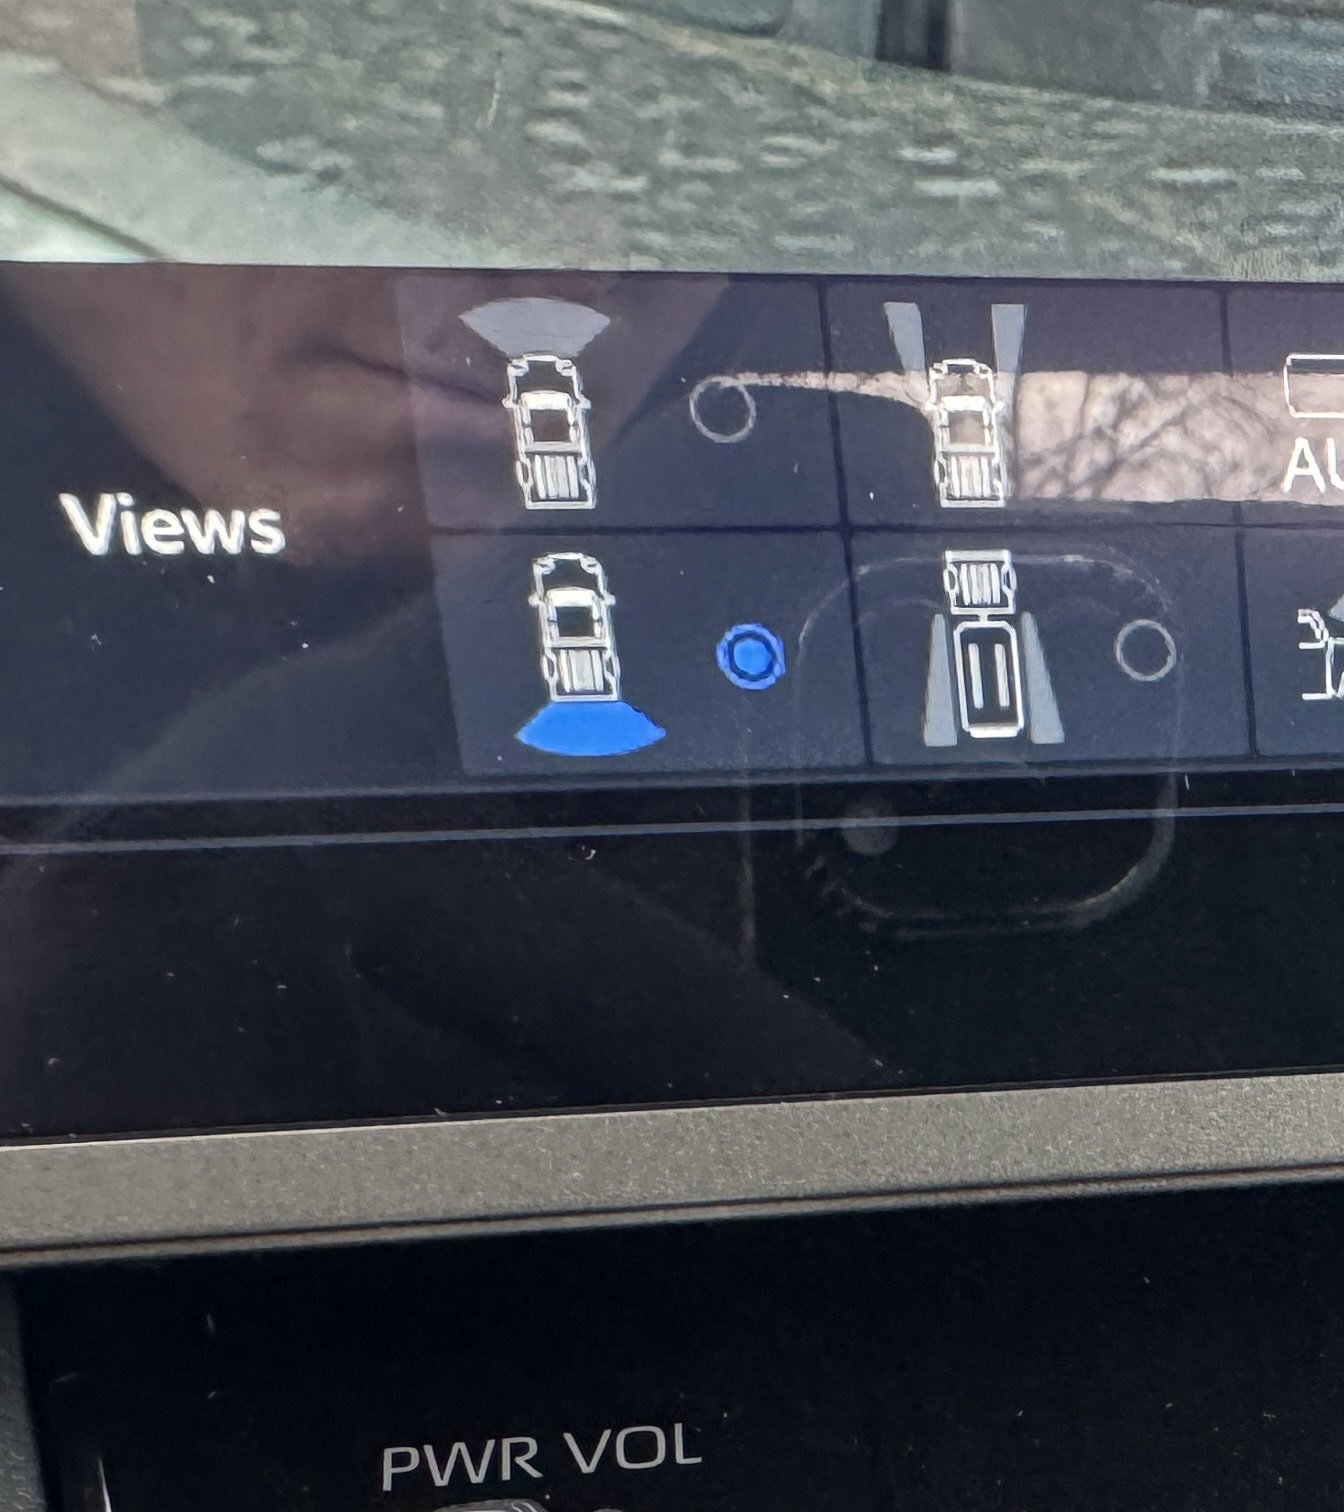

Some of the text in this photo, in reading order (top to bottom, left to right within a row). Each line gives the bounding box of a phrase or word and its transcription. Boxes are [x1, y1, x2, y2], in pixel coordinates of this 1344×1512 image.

[58, 490, 286, 558] Views
[382, 1423, 703, 1491] PWR VOL
